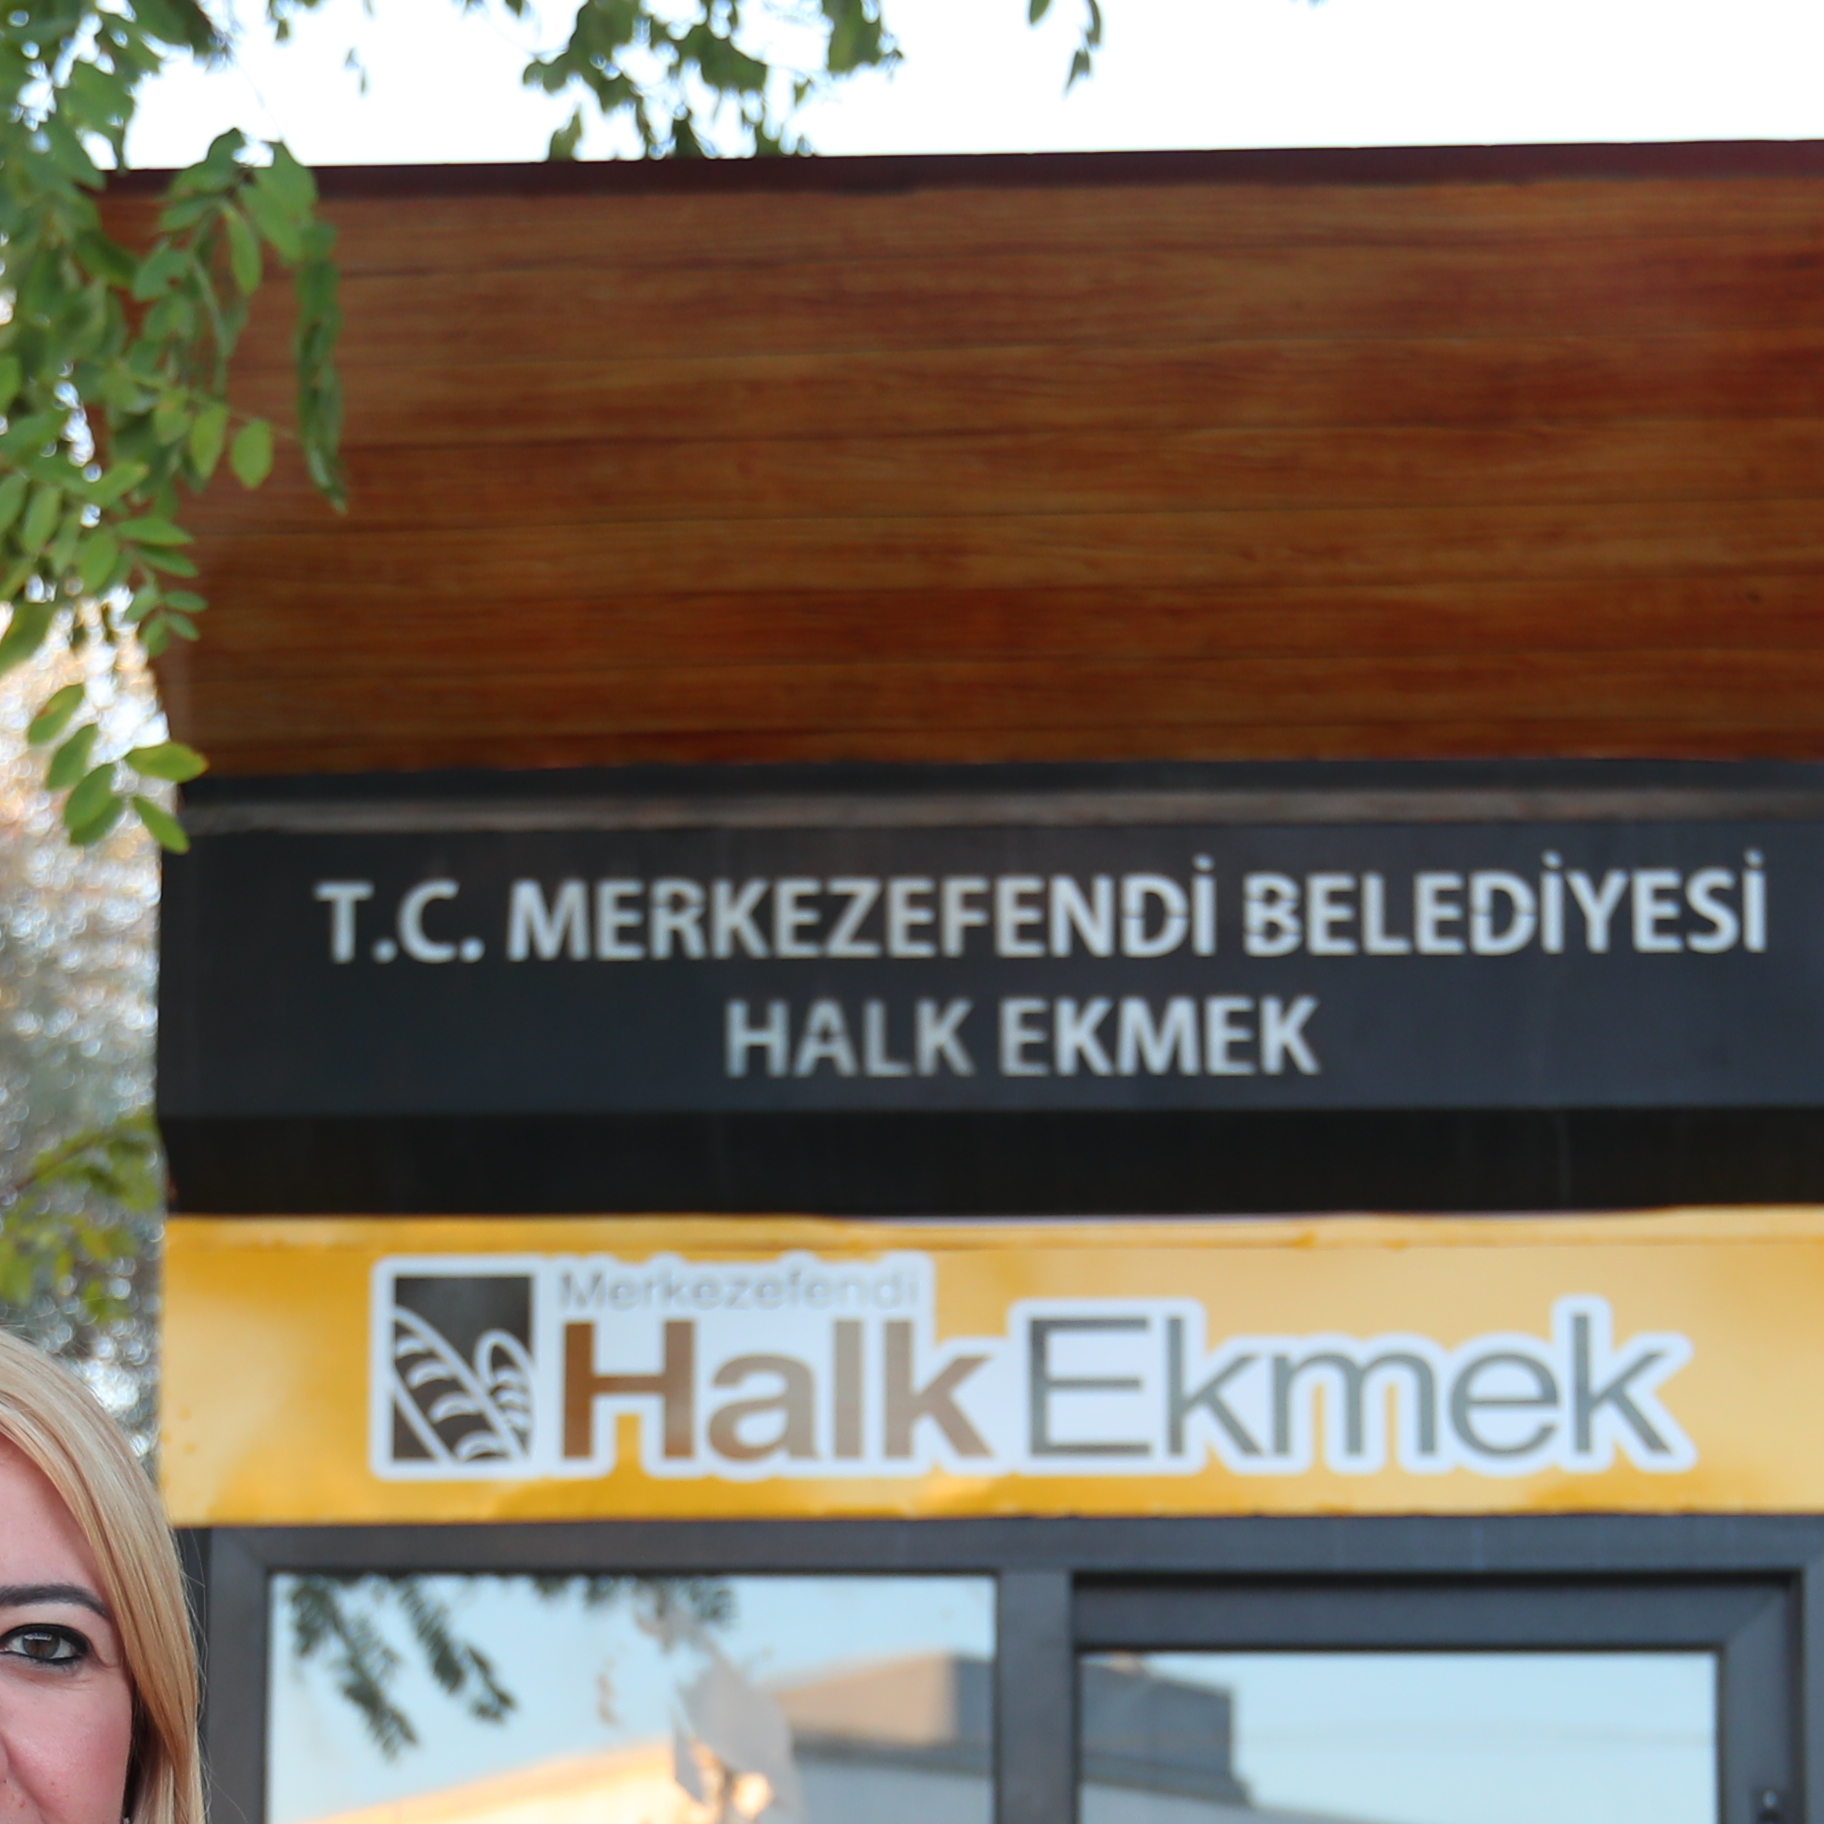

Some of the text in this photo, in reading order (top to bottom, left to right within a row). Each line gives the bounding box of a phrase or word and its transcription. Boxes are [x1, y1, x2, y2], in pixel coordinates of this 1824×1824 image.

[313, 848, 1770, 964] T.C. MERKEZEFENDİ BELEDİYESİ
[723, 995, 1322, 1079] HALK EKMEK
[561, 1266, 921, 1312] Merkezefendi
[562, 1312, 1674, 1463] Halk Ekmek
